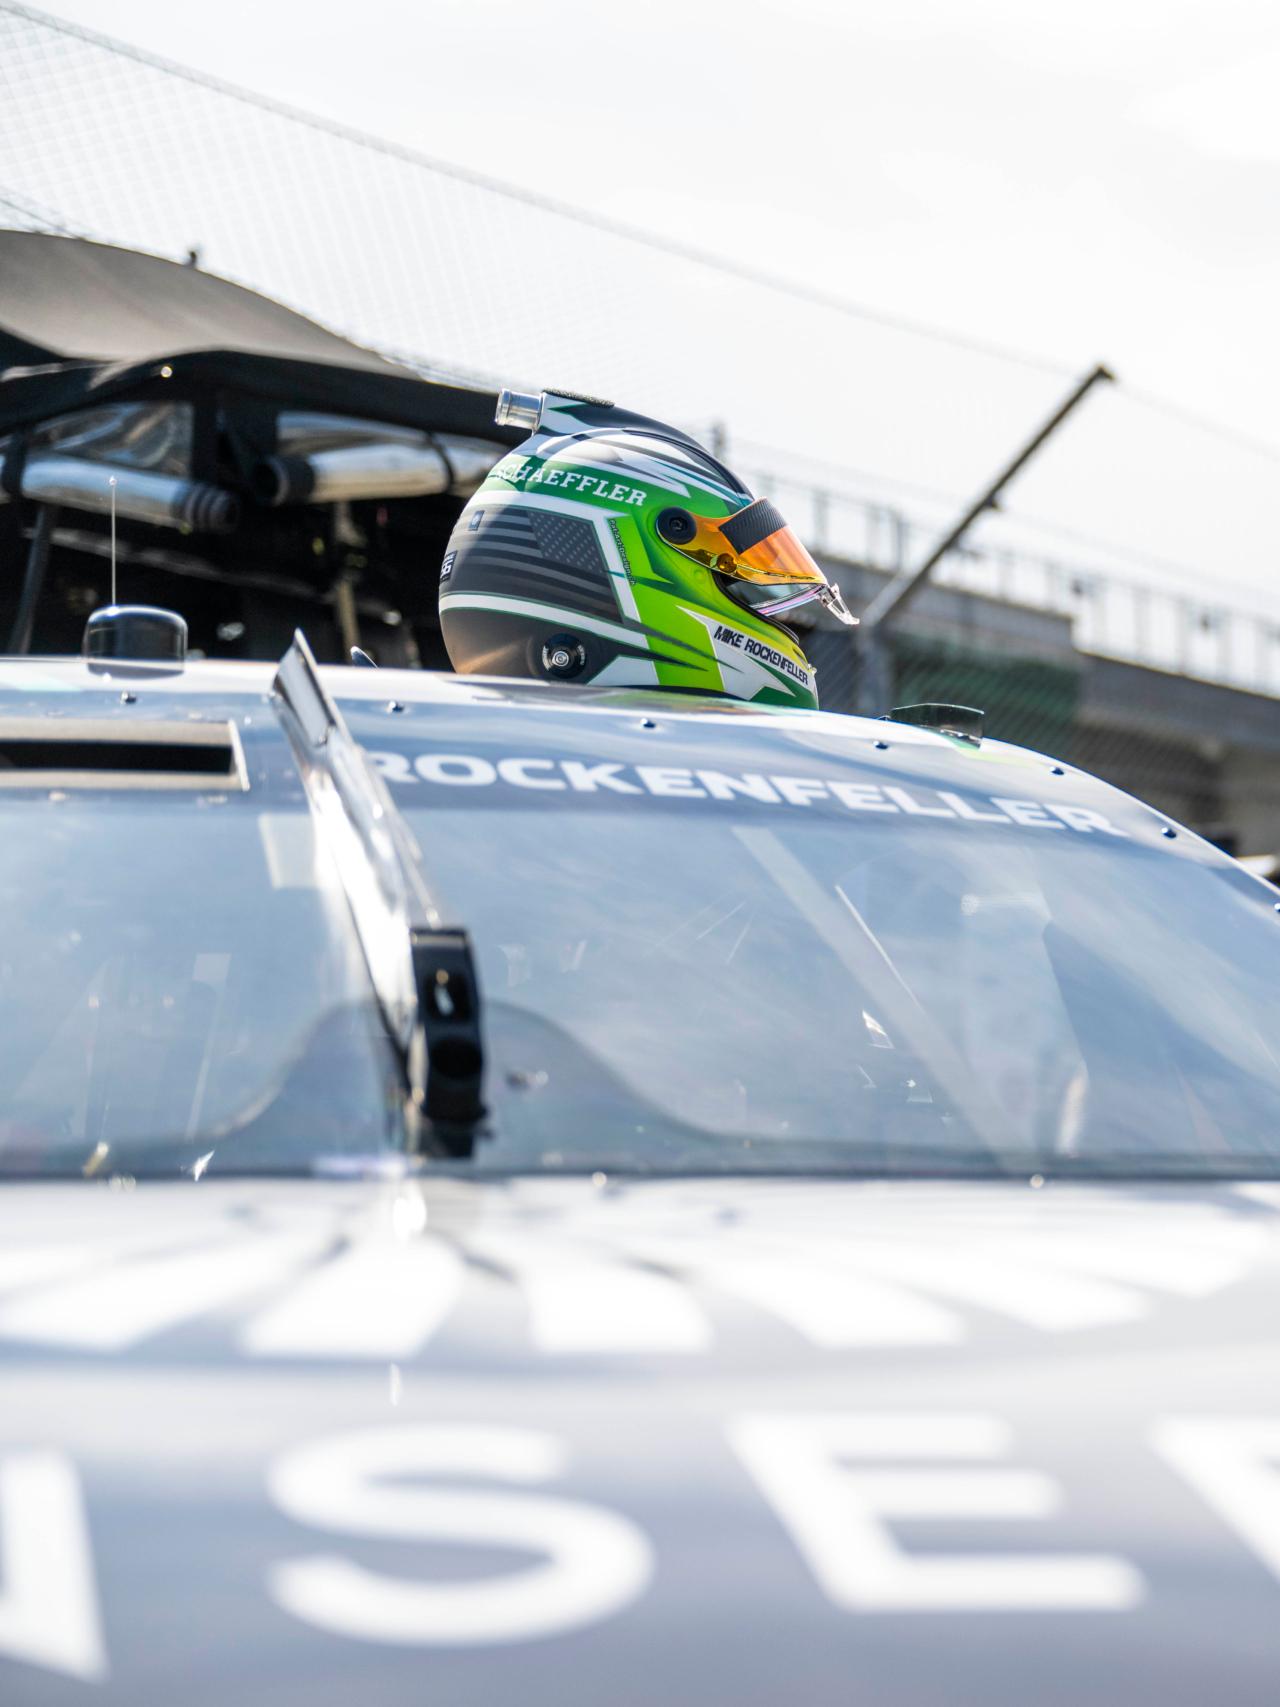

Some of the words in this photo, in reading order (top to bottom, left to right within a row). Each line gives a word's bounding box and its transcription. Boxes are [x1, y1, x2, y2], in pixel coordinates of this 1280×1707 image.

[713, 625, 745, 648] MIKE
[744, 638, 809, 686] ROCKENFELLER
[366, 751, 1129, 838] ROCKENFELLER
